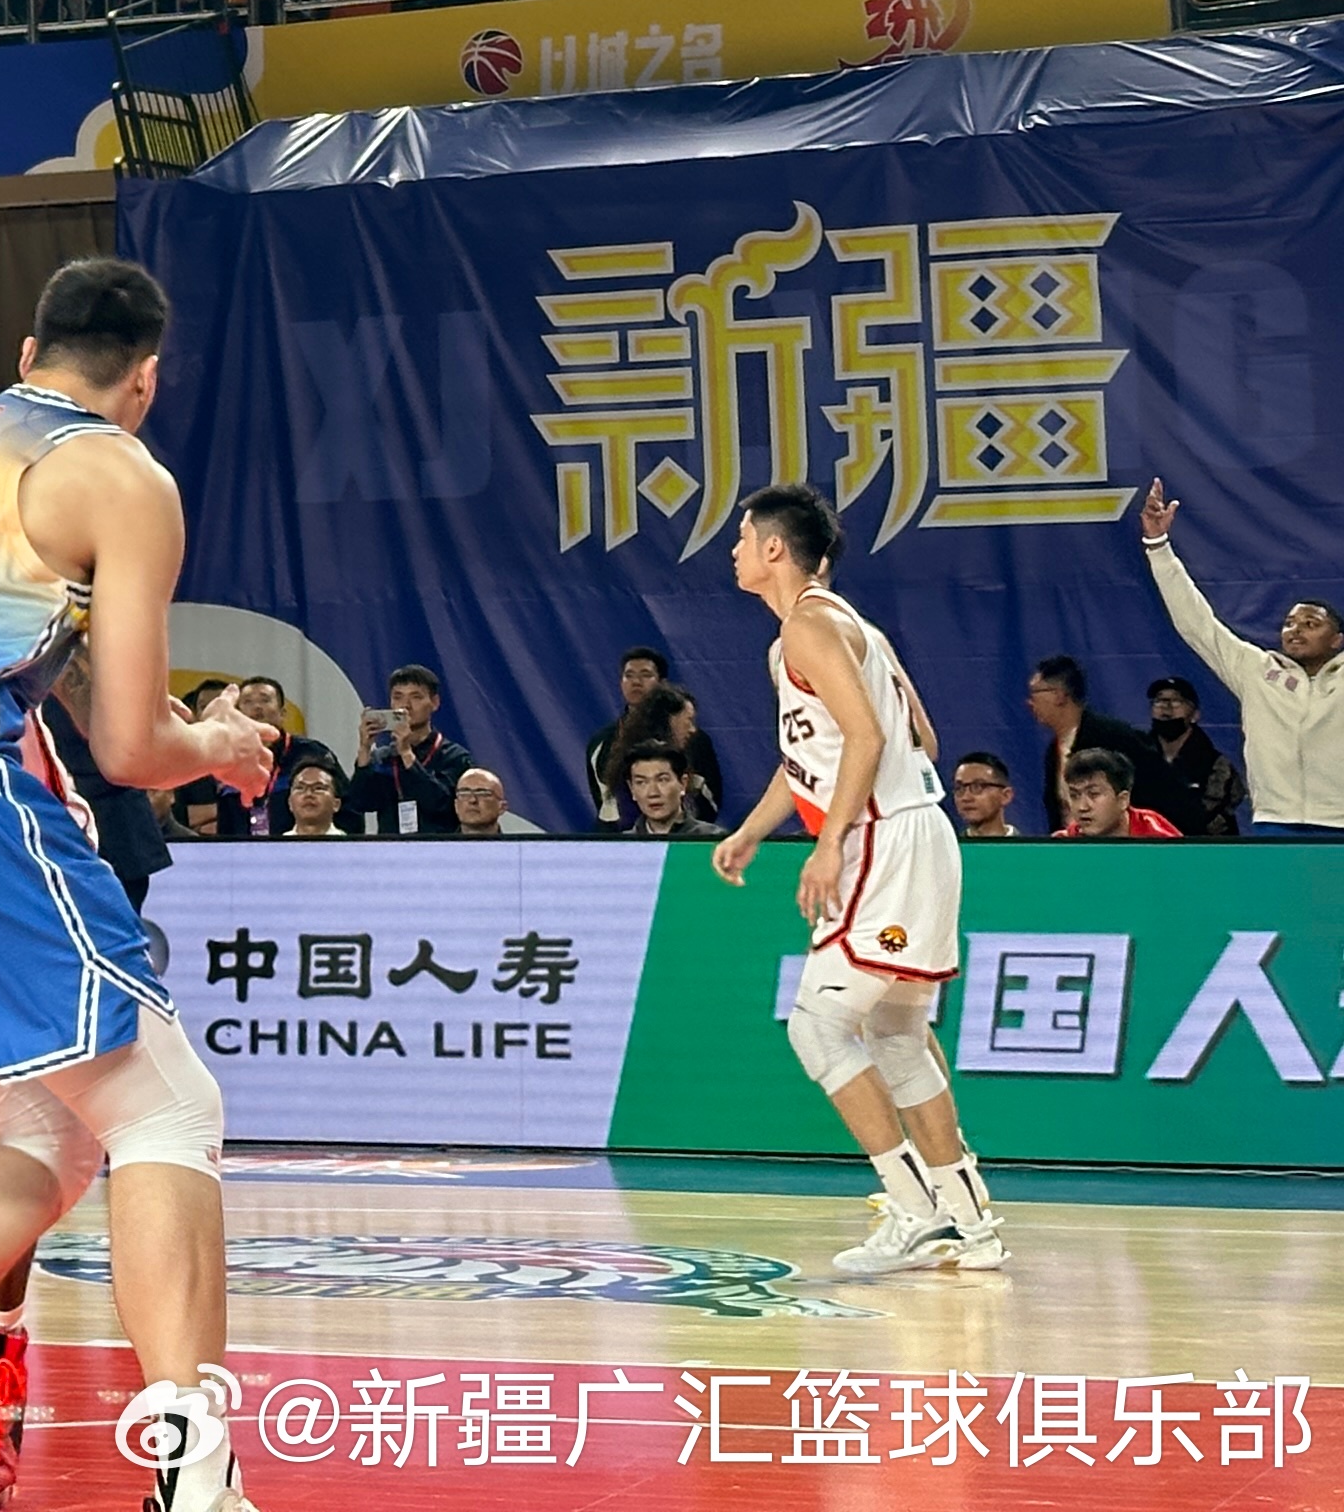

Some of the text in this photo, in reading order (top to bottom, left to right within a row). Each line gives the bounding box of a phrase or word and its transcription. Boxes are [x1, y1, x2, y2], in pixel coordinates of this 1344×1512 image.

[529, 200, 1140, 564] 新疆
[782, 707, 815, 746] 25
[205, 927, 580, 1004] 中国人寿
[204, 1019, 573, 1060] CHINA LIFE
